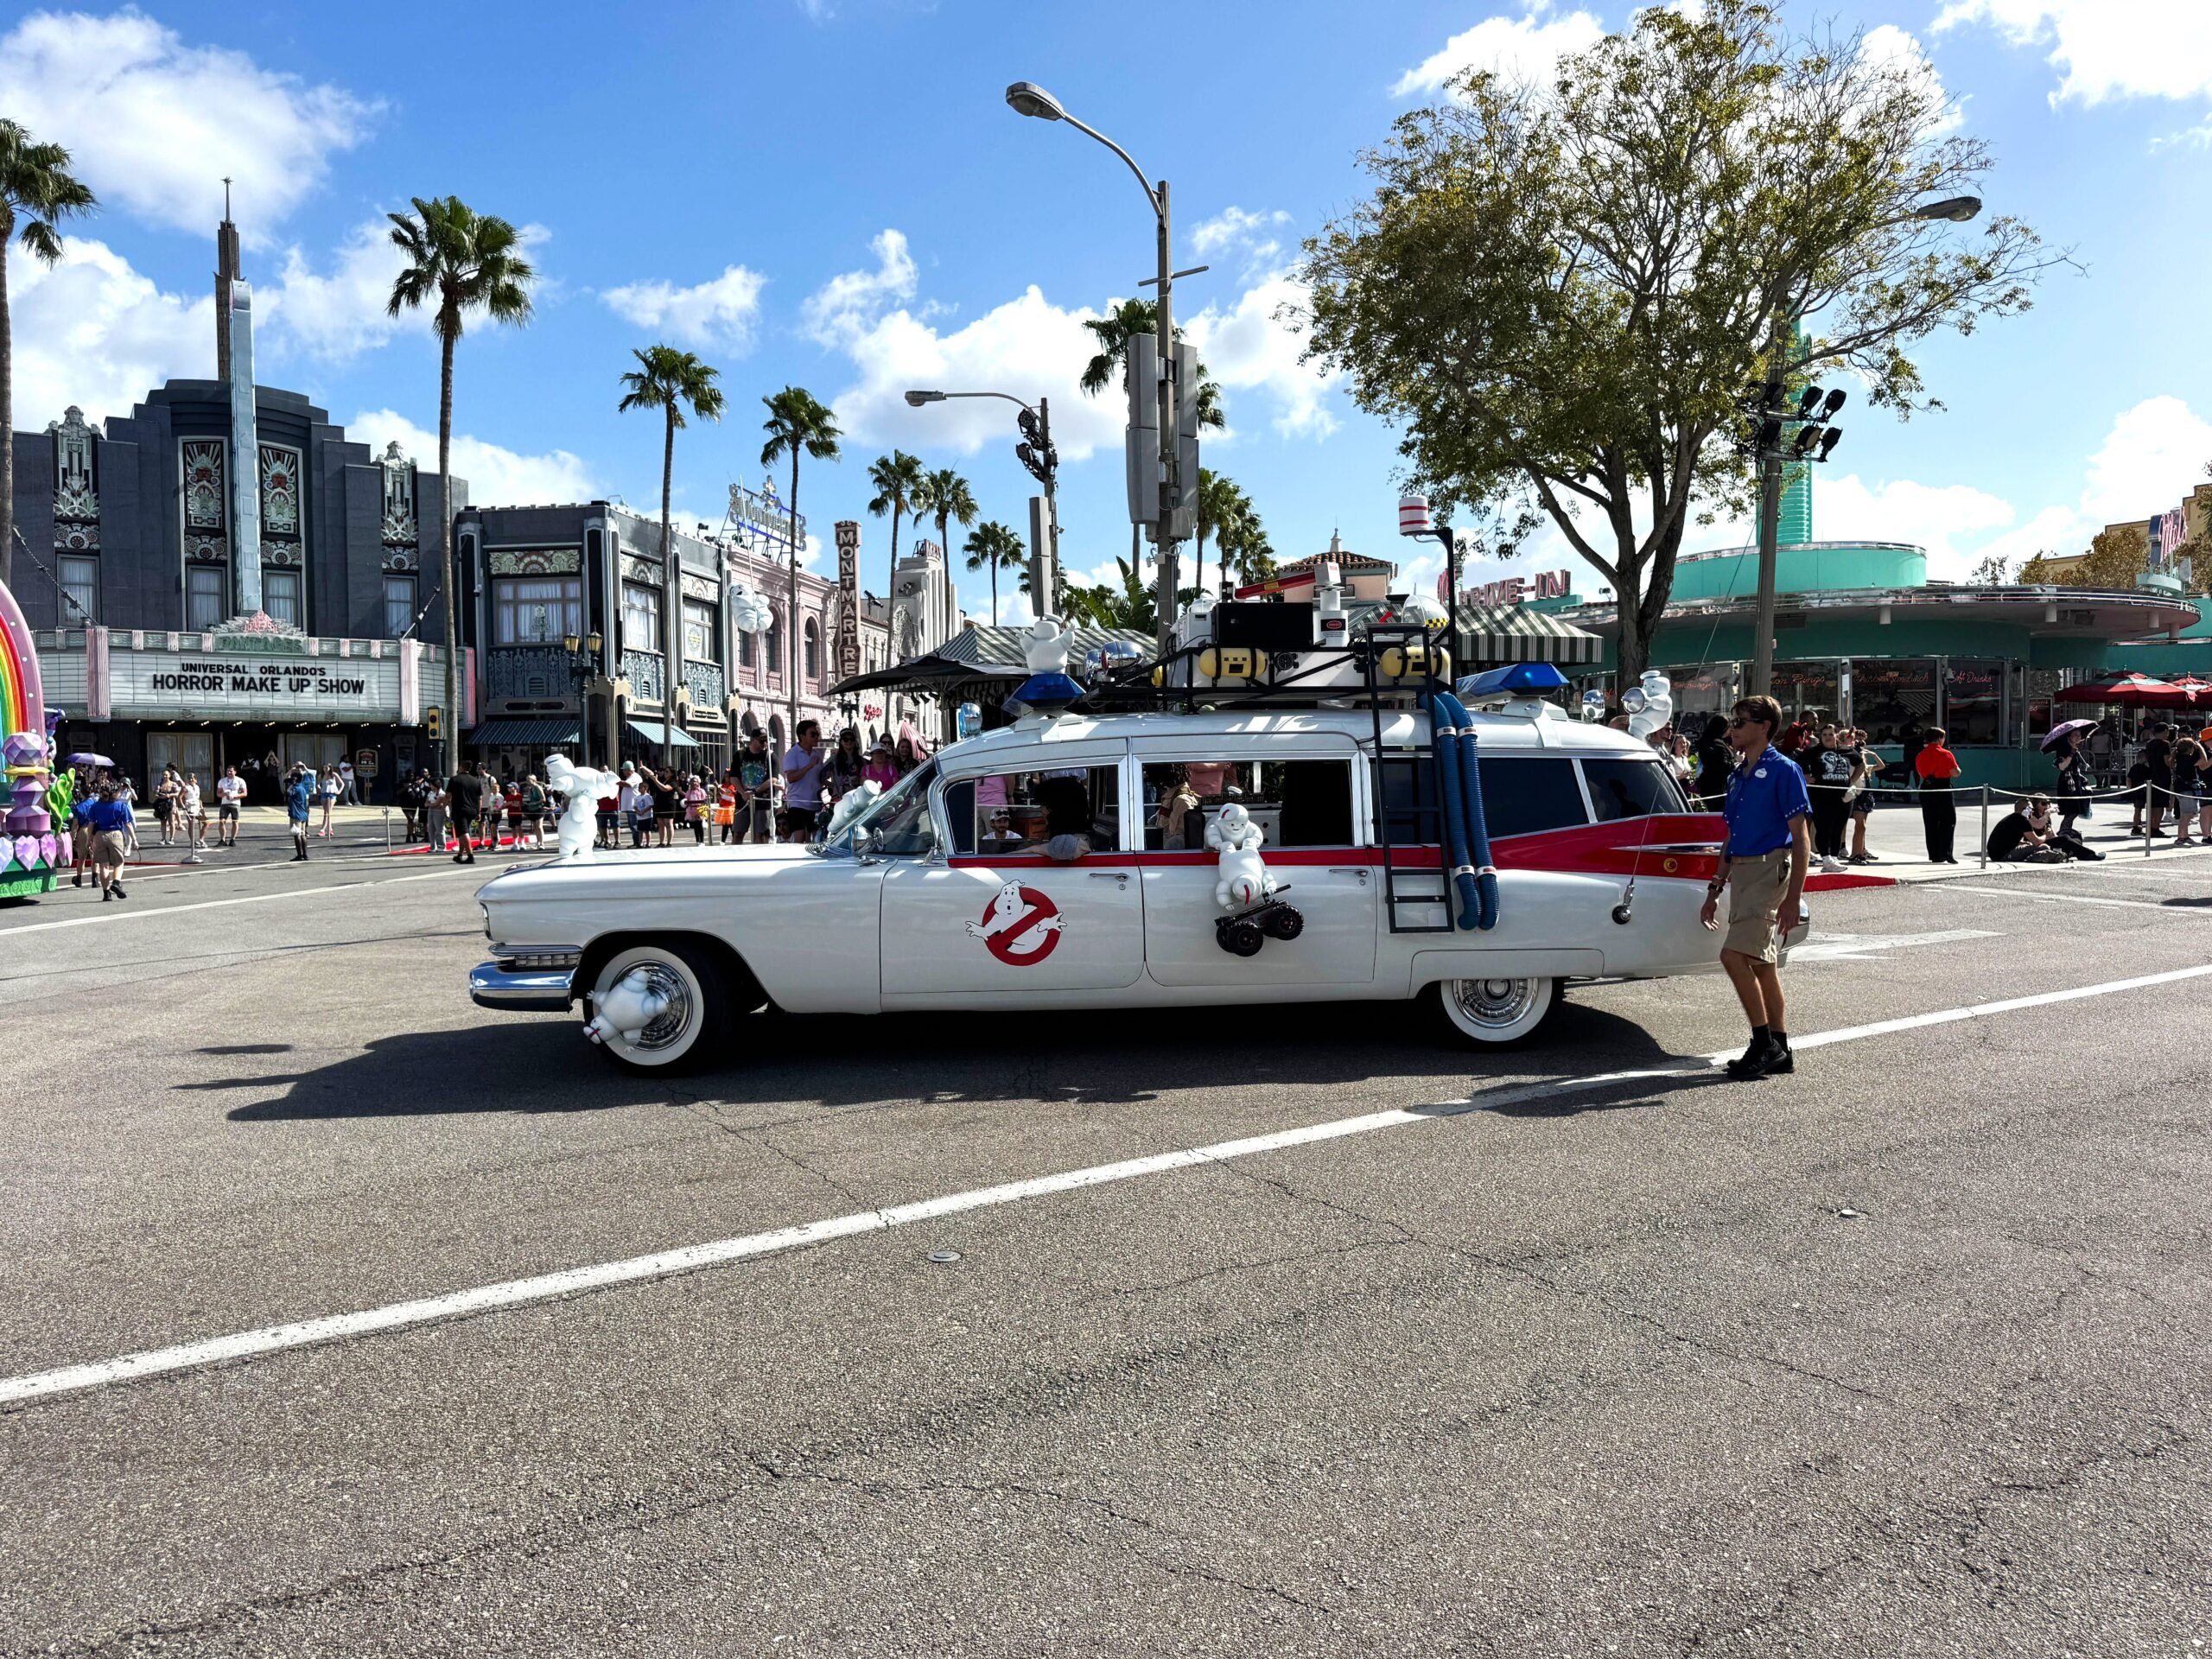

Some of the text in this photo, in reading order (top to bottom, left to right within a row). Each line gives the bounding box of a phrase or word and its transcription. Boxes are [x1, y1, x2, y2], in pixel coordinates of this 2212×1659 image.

[839, 531, 857, 675] MONTMARTRE
[219, 635, 303, 653] PANTAGES
[181, 663, 327, 677] UNIVERSAL ORLANDO'S
[152, 674, 365, 695] HORROR MAKE UP SHOW
